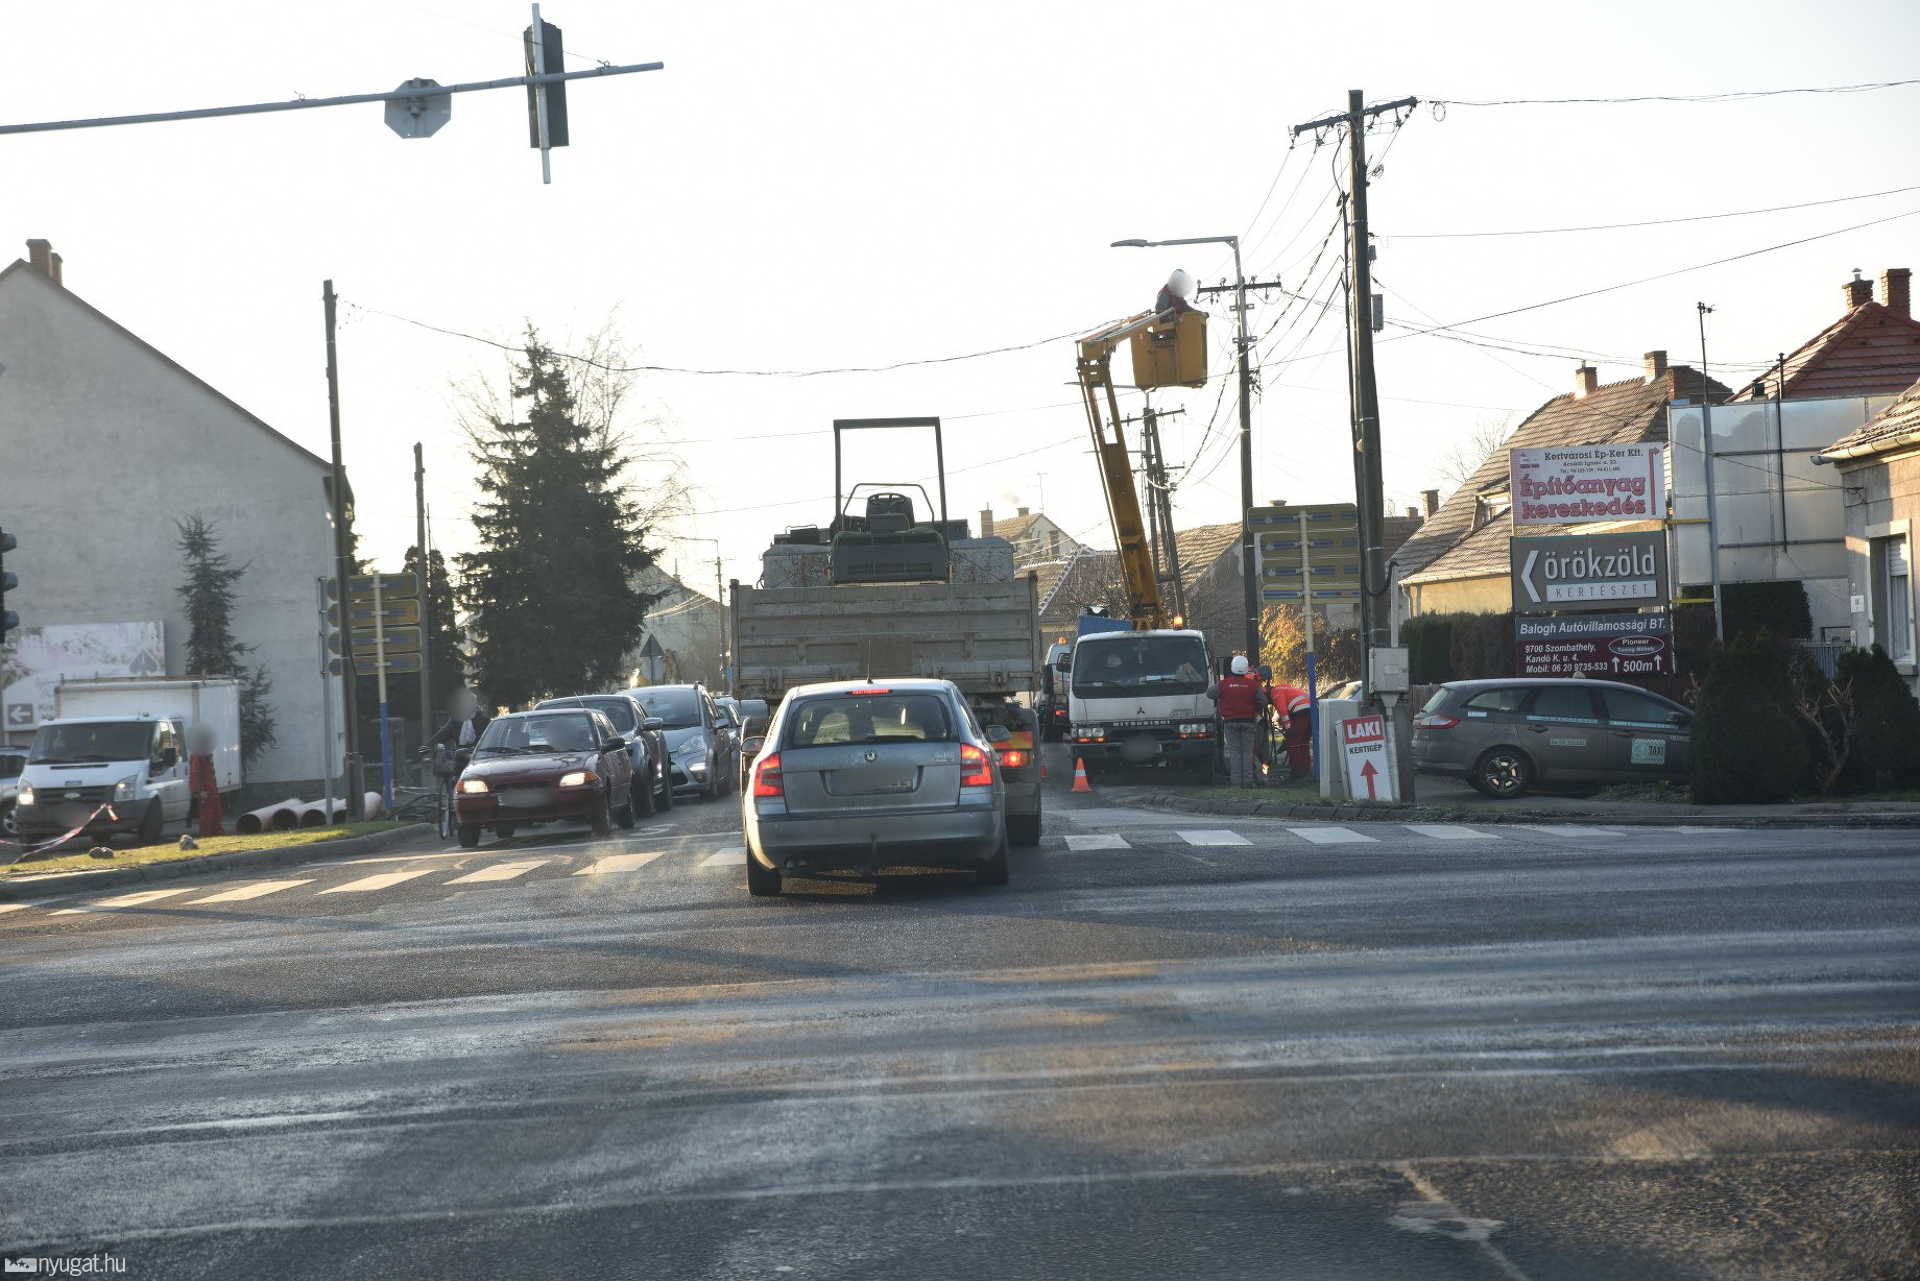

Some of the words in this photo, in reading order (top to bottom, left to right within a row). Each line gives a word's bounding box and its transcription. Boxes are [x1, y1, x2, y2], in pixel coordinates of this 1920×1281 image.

[1627, 448, 1644, 457] Kft.
[1520, 474, 1646, 499] Építőanyag
[1522, 496, 1646, 519] kereskedés
[1544, 544, 1656, 579] örökzöld
[1555, 583, 1648, 598] KERTÉSZET
[1519, 623, 1557, 635] Balogh
[1558, 619, 1647, 633] Autóvillamossági
[1649, 618, 1666, 629] BT.
[1525, 645, 1543, 653] 9700
[1544, 643, 1597, 653] Szombathely,
[1526, 654, 1551, 663] Kandó
[1552, 654, 1561, 662] K.
[1623, 660, 1653, 672] 500m
[1552, 664, 1561, 672] 06
[1563, 663, 1573, 672] 20
[1347, 721, 1382, 738] LAKI
